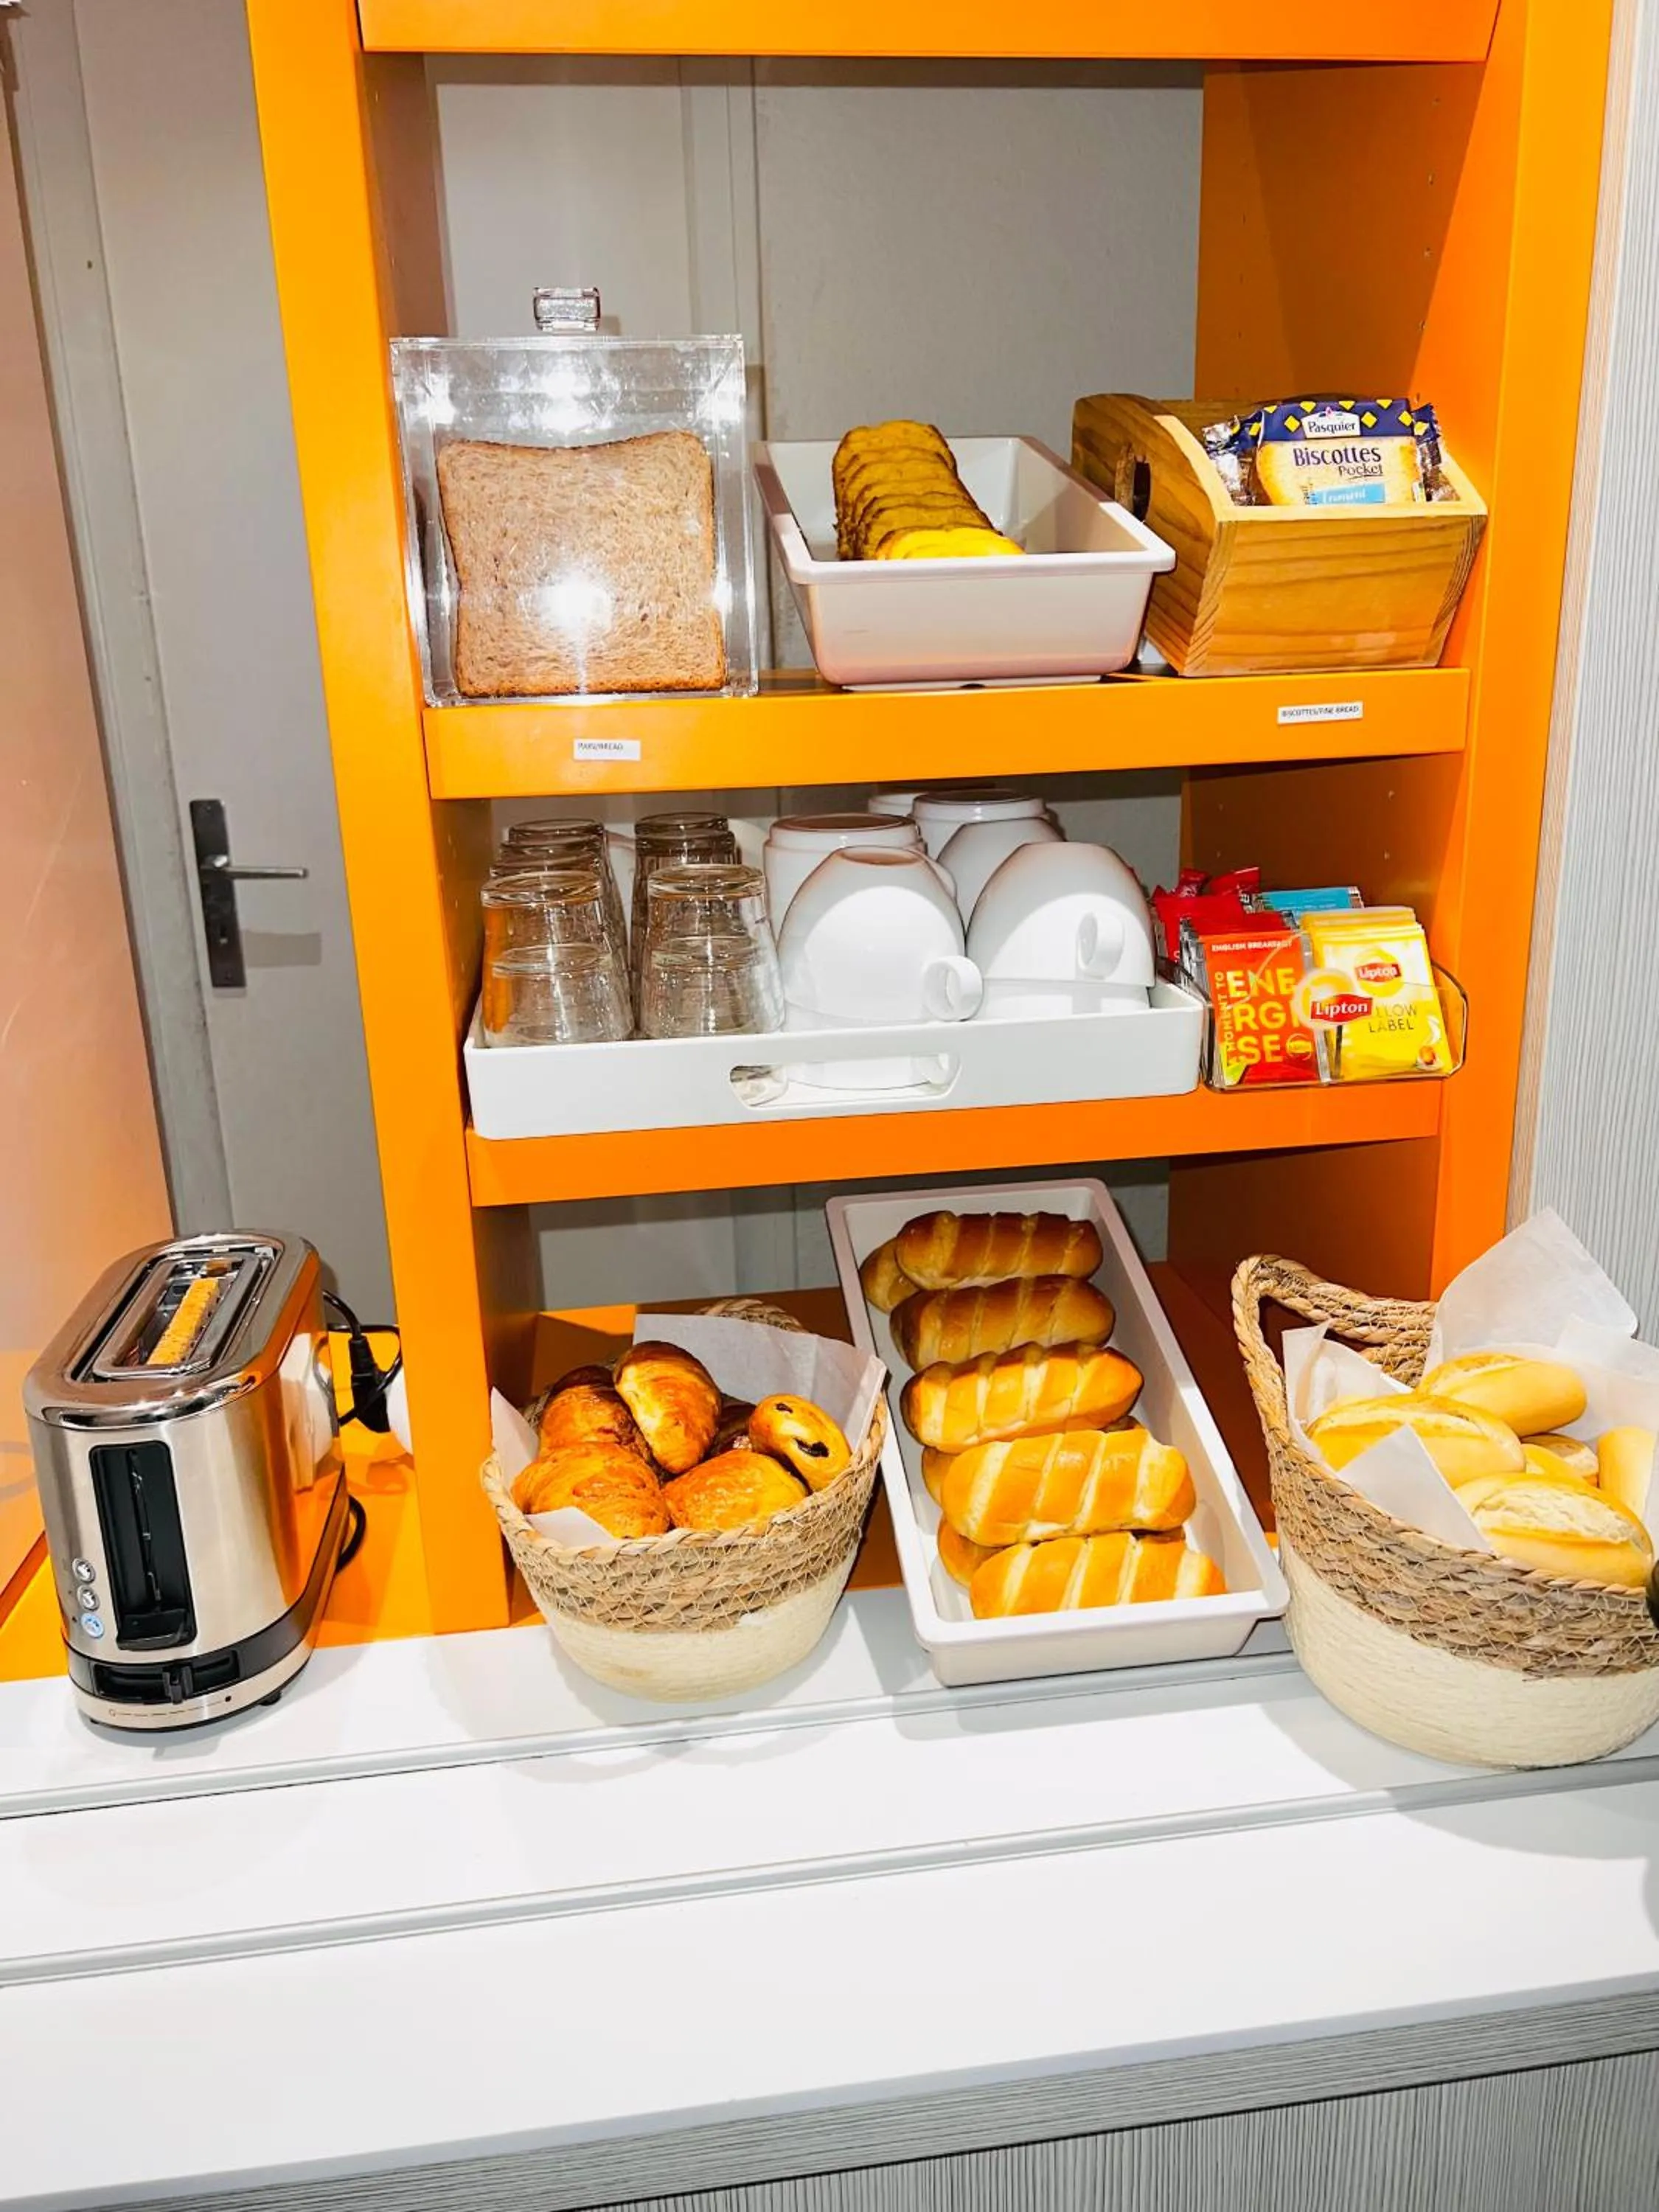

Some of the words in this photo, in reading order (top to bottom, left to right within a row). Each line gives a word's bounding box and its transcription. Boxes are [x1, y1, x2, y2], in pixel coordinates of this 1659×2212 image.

[1307, 420, 1356, 434] Pasquier
[1293, 445, 1382, 467] Biscottes
[1338, 463, 1383, 476] Pocket
[1211, 943, 1246, 952] ENGLISH
[1215, 971, 1226, 989] TO
[1358, 967, 1398, 980] Lipton
[1315, 1002, 1368, 1018] Lipton
[1368, 1018, 1414, 1033] LABEL
[1237, 1034, 1284, 1065] SE
